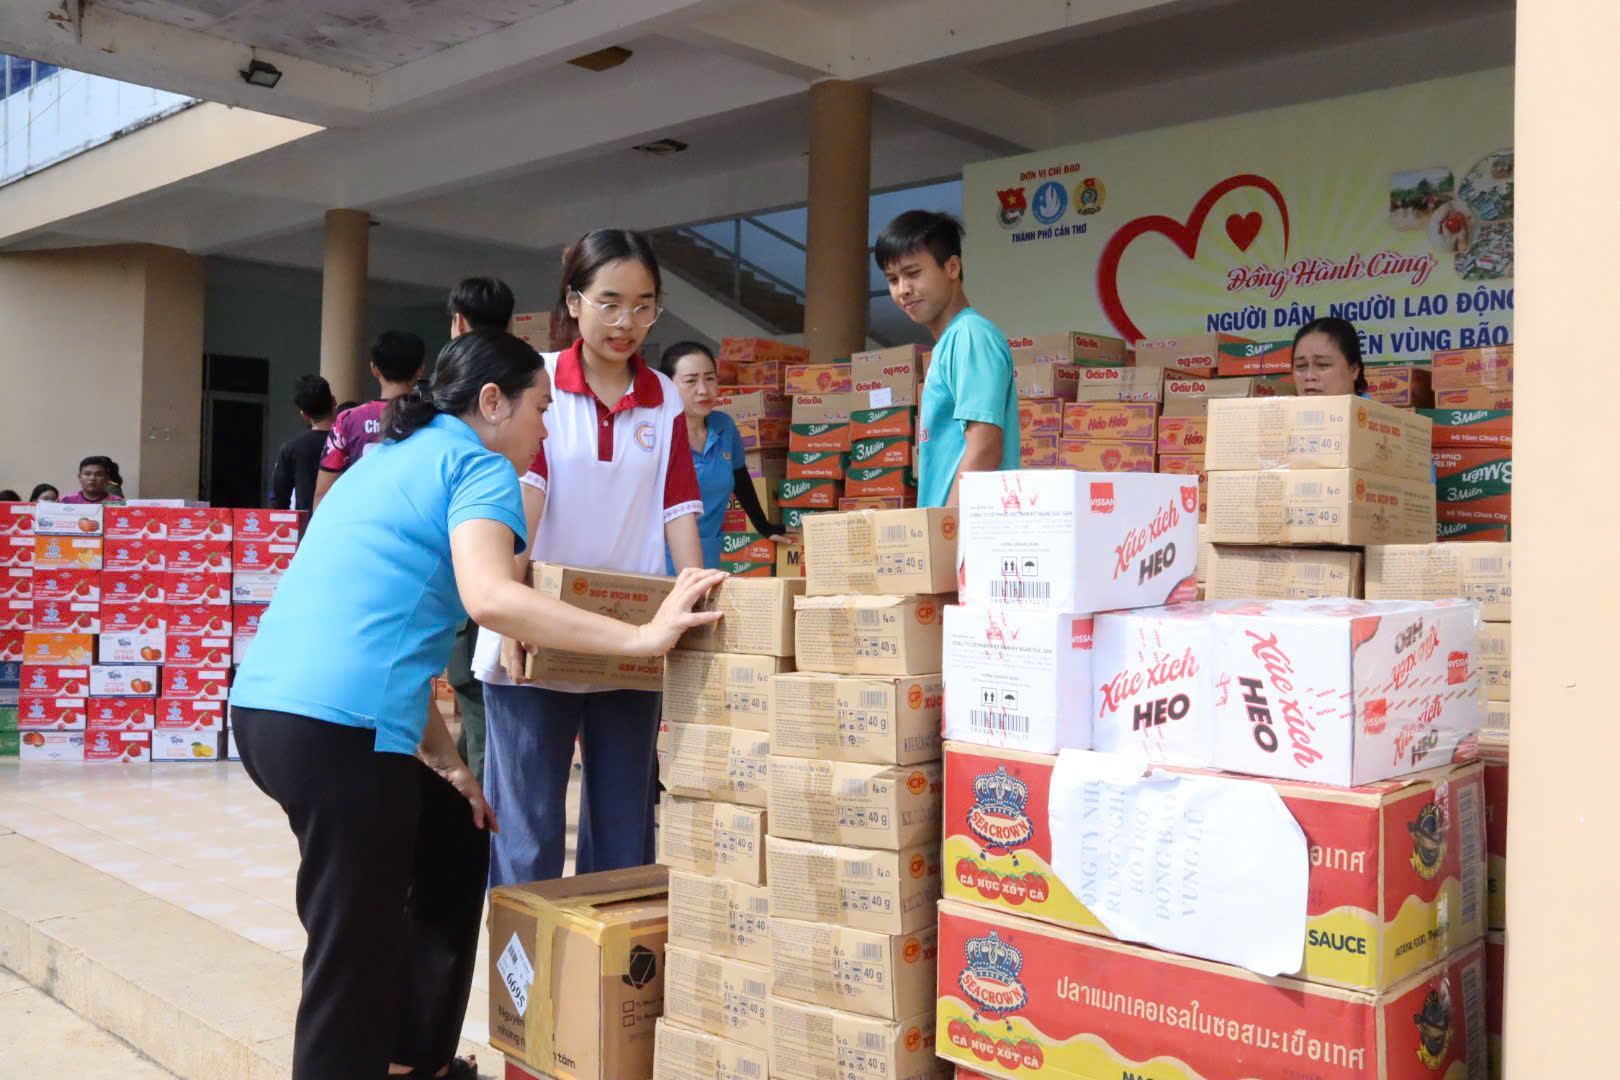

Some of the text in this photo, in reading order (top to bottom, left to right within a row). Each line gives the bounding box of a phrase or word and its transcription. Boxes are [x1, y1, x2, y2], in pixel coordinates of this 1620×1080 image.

[1037, 227, 1052, 240] PHỐ
[1072, 223, 1087, 234] THƠ
[1227, 251, 1438, 299] Đồng Hành Cùng
[1206, 303, 1266, 333] NGƯỜI
[1329, 294, 1395, 322] NGƯỜI
[1403, 293, 1448, 318] LAO
[1356, 323, 1509, 355] ÊN VÙNG BÃO
[365, 419, 381, 433] Ch
[1321, 438, 1340, 450] 40 g
[1319, 511, 1338, 523] 40 g
[1113, 499, 1180, 580] Xúc xích
[905, 557, 924, 569] 40 g
[1138, 541, 1177, 587] HEO
[1072, 634, 1093, 644] VISSA
[880, 641, 897, 654] 40 g
[1099, 647, 1200, 719] Xúc xích
[751, 698, 760, 708] 40
[1244, 629, 1324, 769] Xúc xích
[1132, 693, 1190, 731] HEO
[1238, 675, 1279, 753] HEO
[868, 716, 886, 730] 40 g
[757, 765, 767, 775] 40
[868, 812, 887, 826] 40 g
[737, 838, 746, 848] 40
[1310, 845, 1365, 873] อเทศ
[960, 873, 1045, 901] CÁ NỤC XỐT CÀ
[871, 896, 890, 910] 40 g
[756, 920, 765, 931] 40
[1308, 929, 1367, 955] SAUCE
[864, 968, 882, 983] 40 g
[506, 973, 525, 1008] 6695
[749, 1002, 759, 1014] 40
[953, 1034, 1039, 1068] CÁ NỤC XỐT CÀ
[867, 1057, 886, 1073] 40 g
